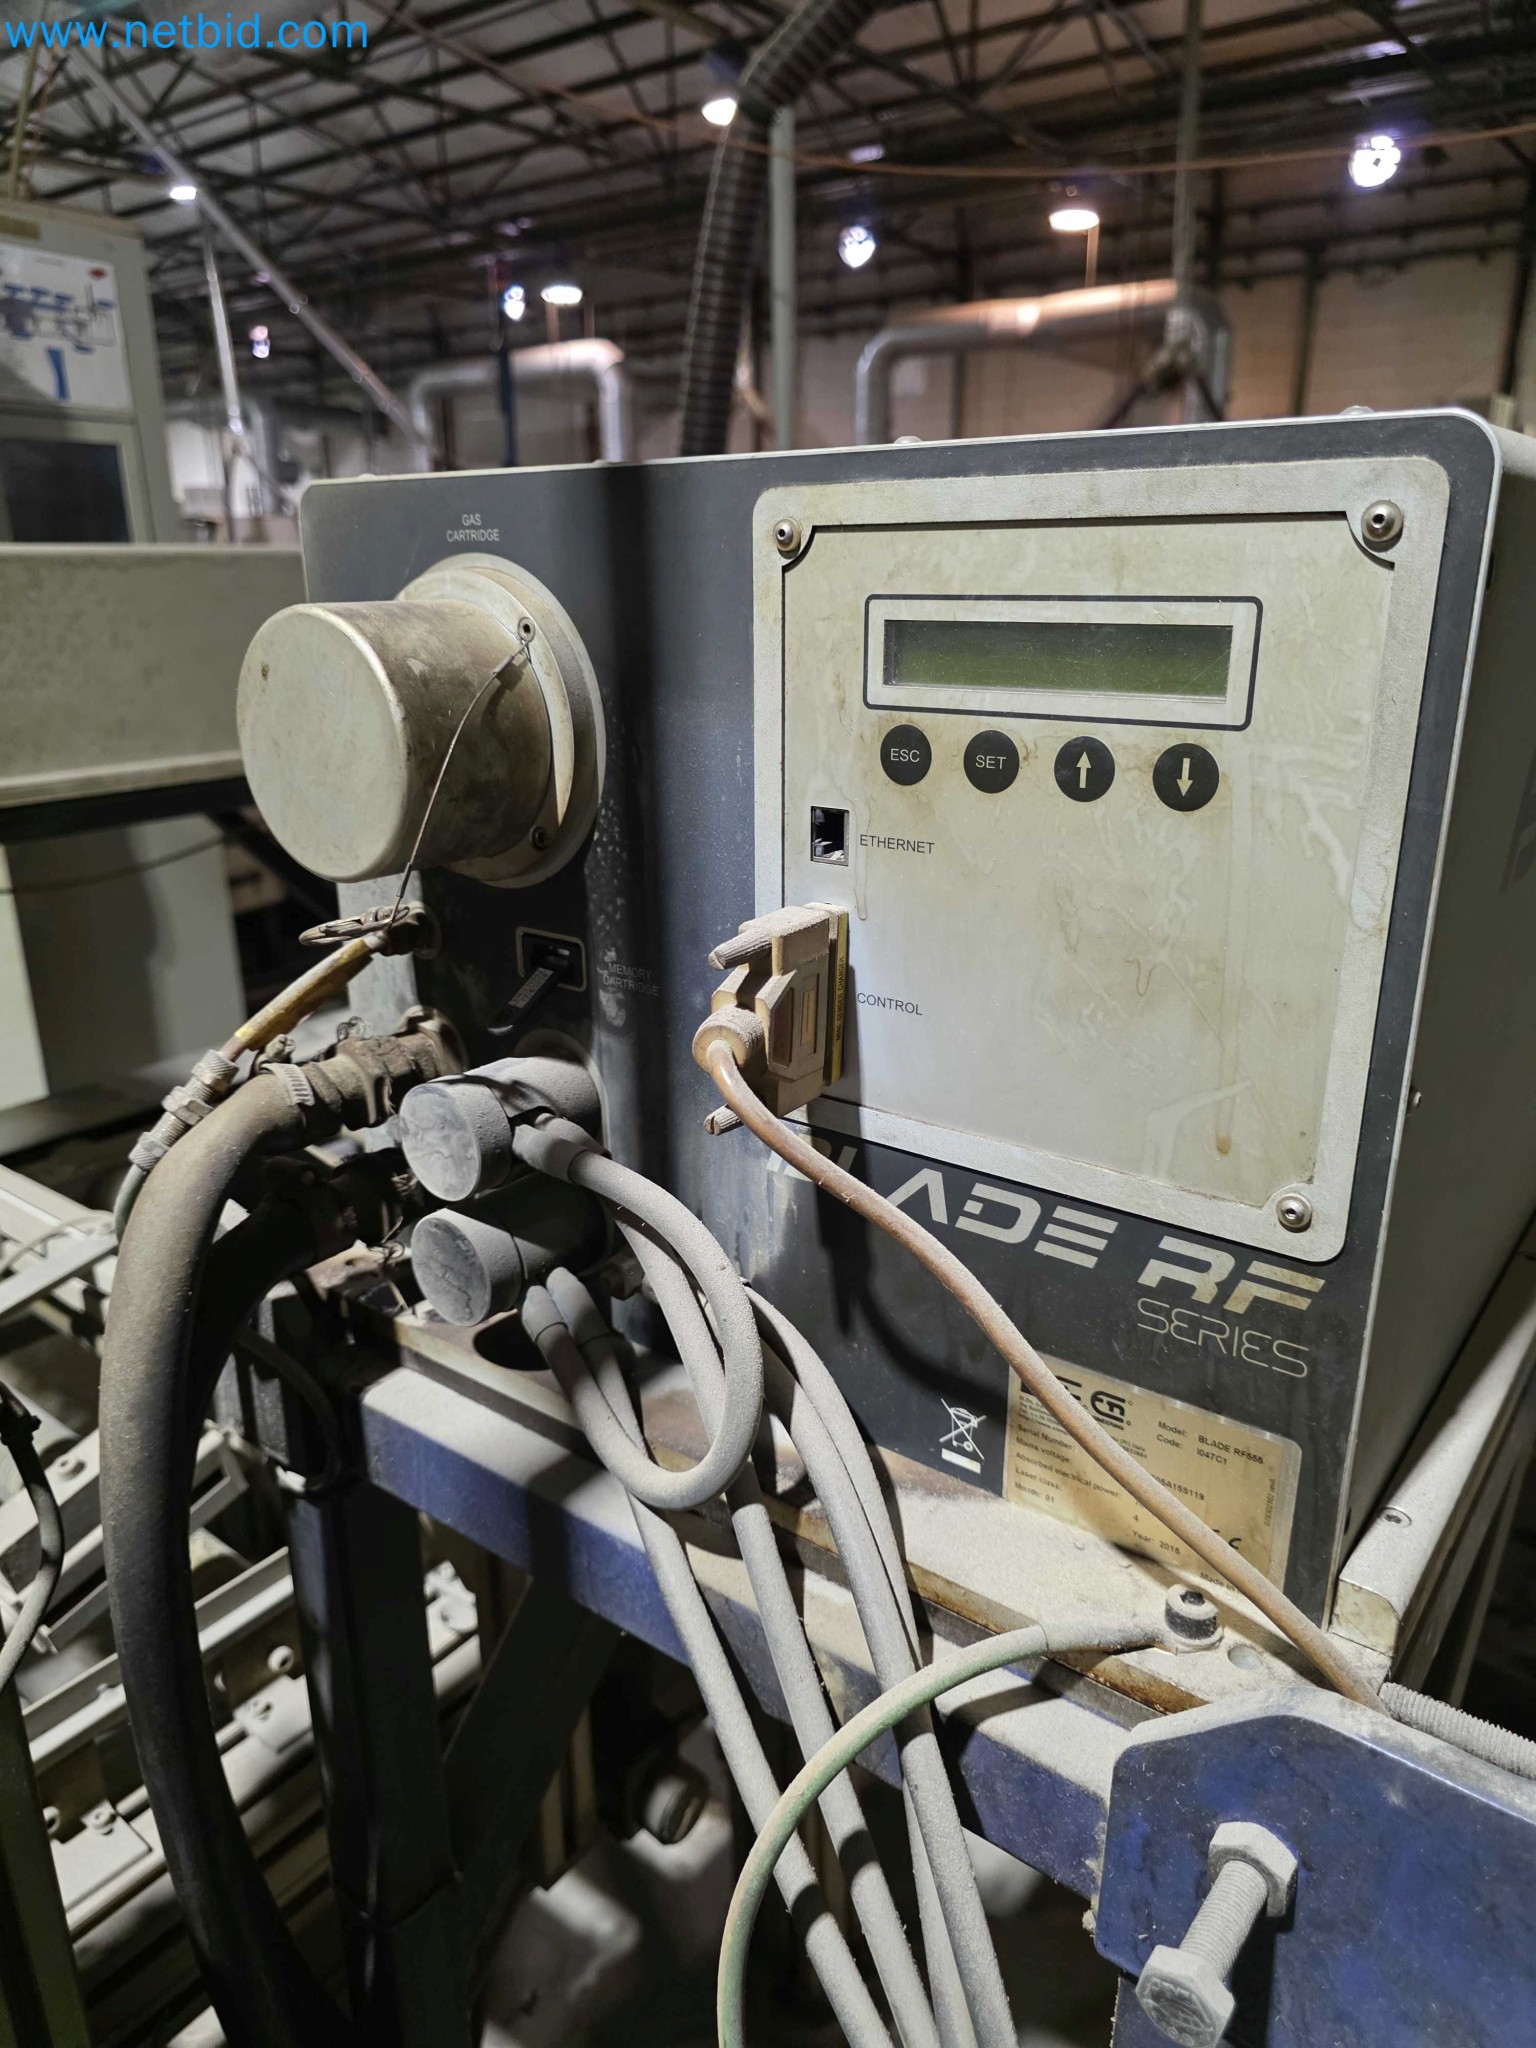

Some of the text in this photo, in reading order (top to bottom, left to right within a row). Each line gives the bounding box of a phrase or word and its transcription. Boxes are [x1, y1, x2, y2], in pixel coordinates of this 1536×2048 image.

[462, 513, 482, 527] GAS
[446, 528, 500, 542] CARTRIDGE
[890, 748, 920, 763] ESC
[975, 755, 1007, 771] SET
[860, 834, 935, 854] ETHERNET
[608, 963, 656, 979] MEMORY
[838, 956, 846, 991] CHANGER
[603, 975, 660, 996] CARTRIDGE
[836, 993, 844, 1021] GENDER
[857, 992, 923, 1016] CONTROL
[1137, 1235, 1326, 1315] RF
[1137, 1297, 1309, 1378] SERIES
[1017, 1423, 1040, 1438] Serial
[1016, 1436, 1039, 1451] Mains
[1157, 1434, 1183, 1449] Code:
[1158, 1421, 1264, 1464] Model: BLADE RF555
[1015, 1466, 1036, 1480] Laser
[1016, 1452, 1053, 1472] Absorbed
[1055, 1469, 1091, 1487] electrical
[1200, 1571, 1224, 1587] Made
